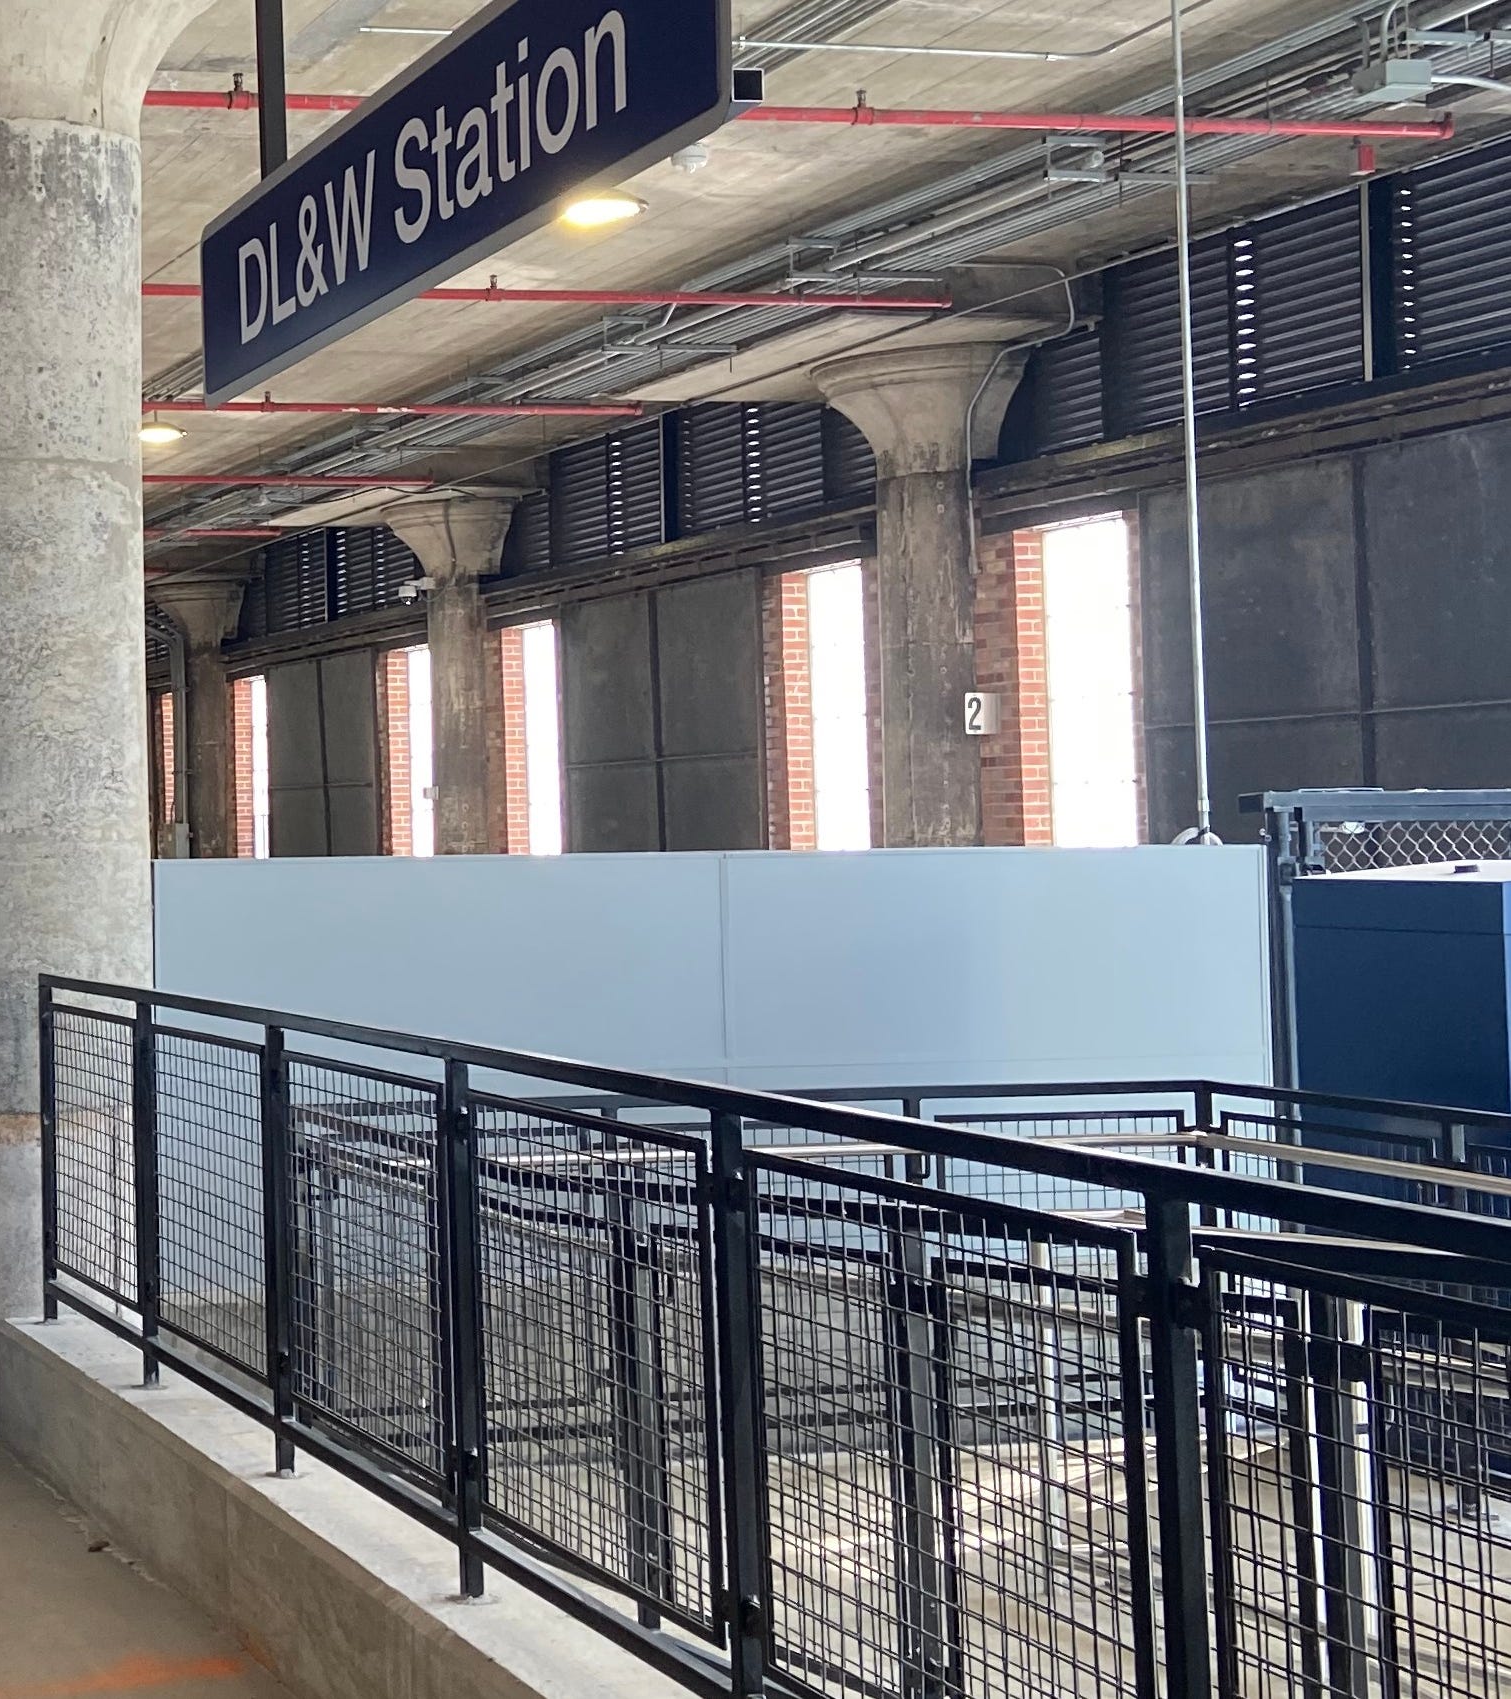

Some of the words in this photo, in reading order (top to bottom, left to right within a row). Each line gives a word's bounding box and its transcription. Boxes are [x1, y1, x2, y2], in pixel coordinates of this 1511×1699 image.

[239, 149, 375, 345] DL&W
[394, 9, 627, 244] Station
[967, 696, 982, 731] 2
